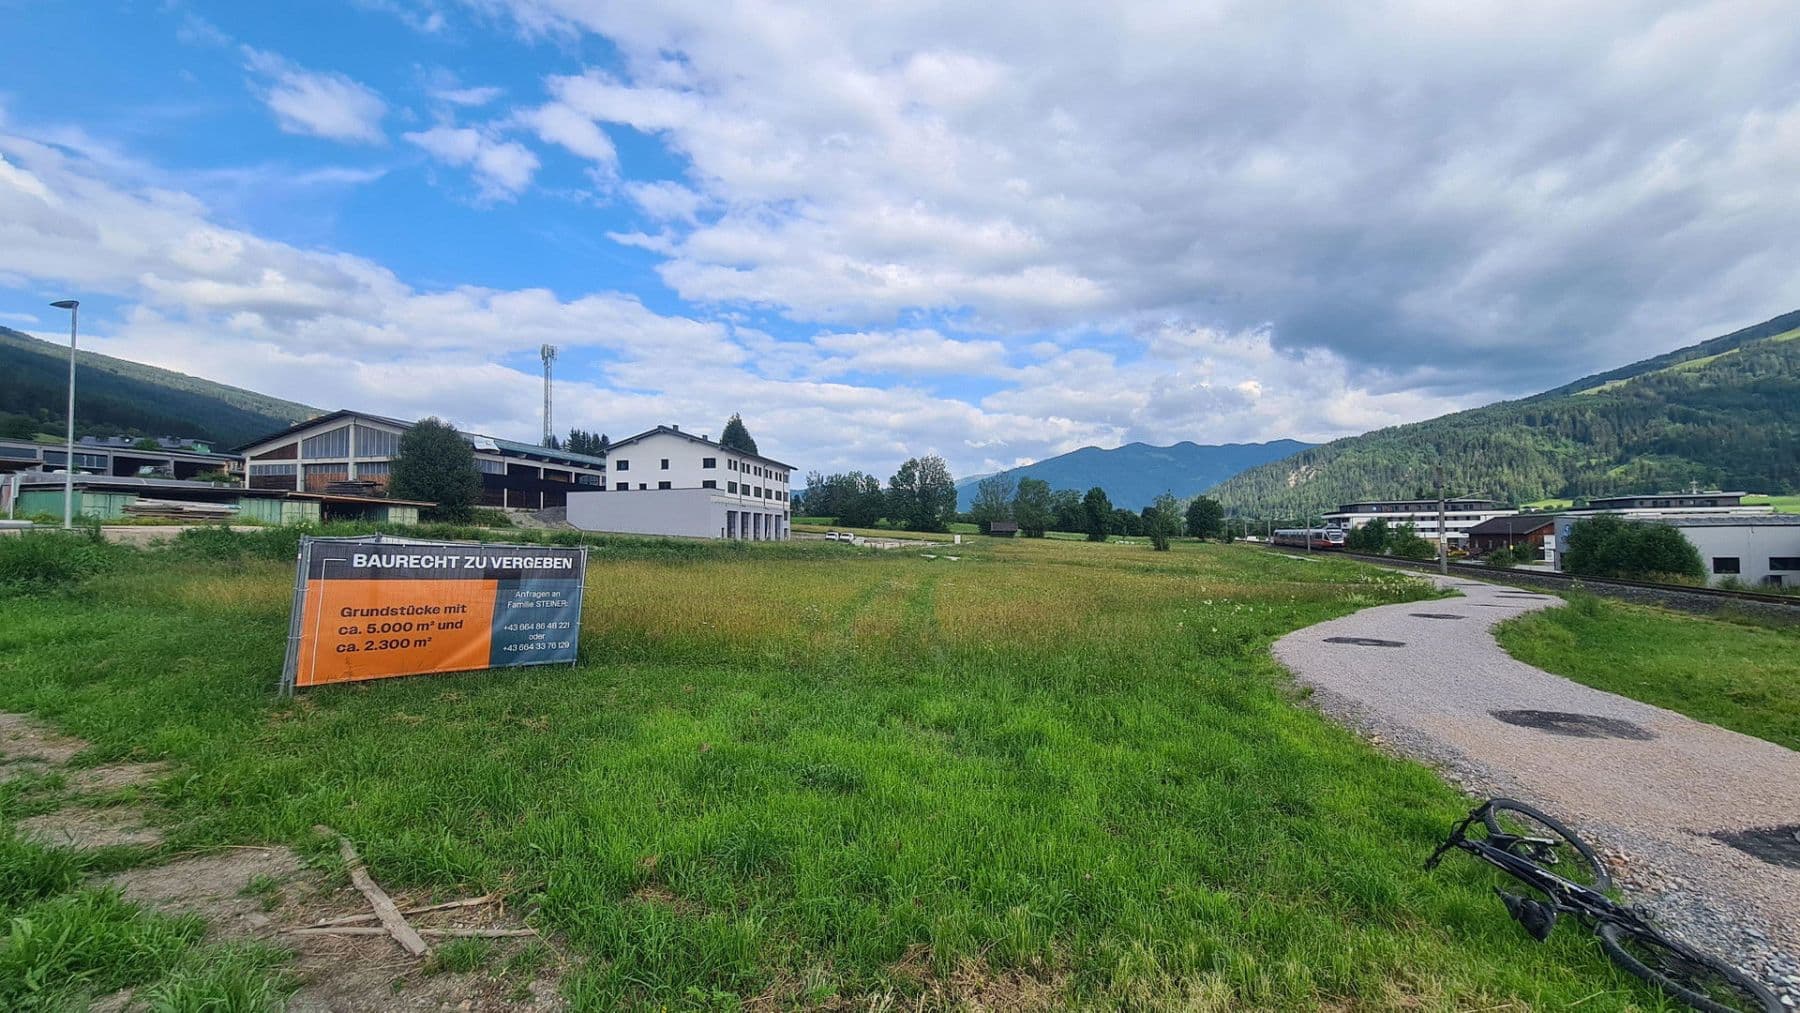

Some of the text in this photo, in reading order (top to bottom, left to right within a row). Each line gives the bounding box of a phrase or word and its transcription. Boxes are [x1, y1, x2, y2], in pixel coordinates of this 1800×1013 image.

[352, 553, 573, 569] BAURECHT ZU VERGEBEN
[515, 590, 550, 599] Anfragen
[507, 600, 533, 609] Familie
[340, 604, 467, 617] Grundstücke mit
[338, 625, 362, 635] ca.
[366, 622, 413, 634] 5.000
[437, 619, 463, 630] und
[519, 623, 534, 631] 664
[558, 621, 570, 629] 221
[336, 642, 360, 653] ca.
[364, 638, 410, 651] 2.300
[503, 644, 518, 652] +43
[519, 643, 534, 651] 664
